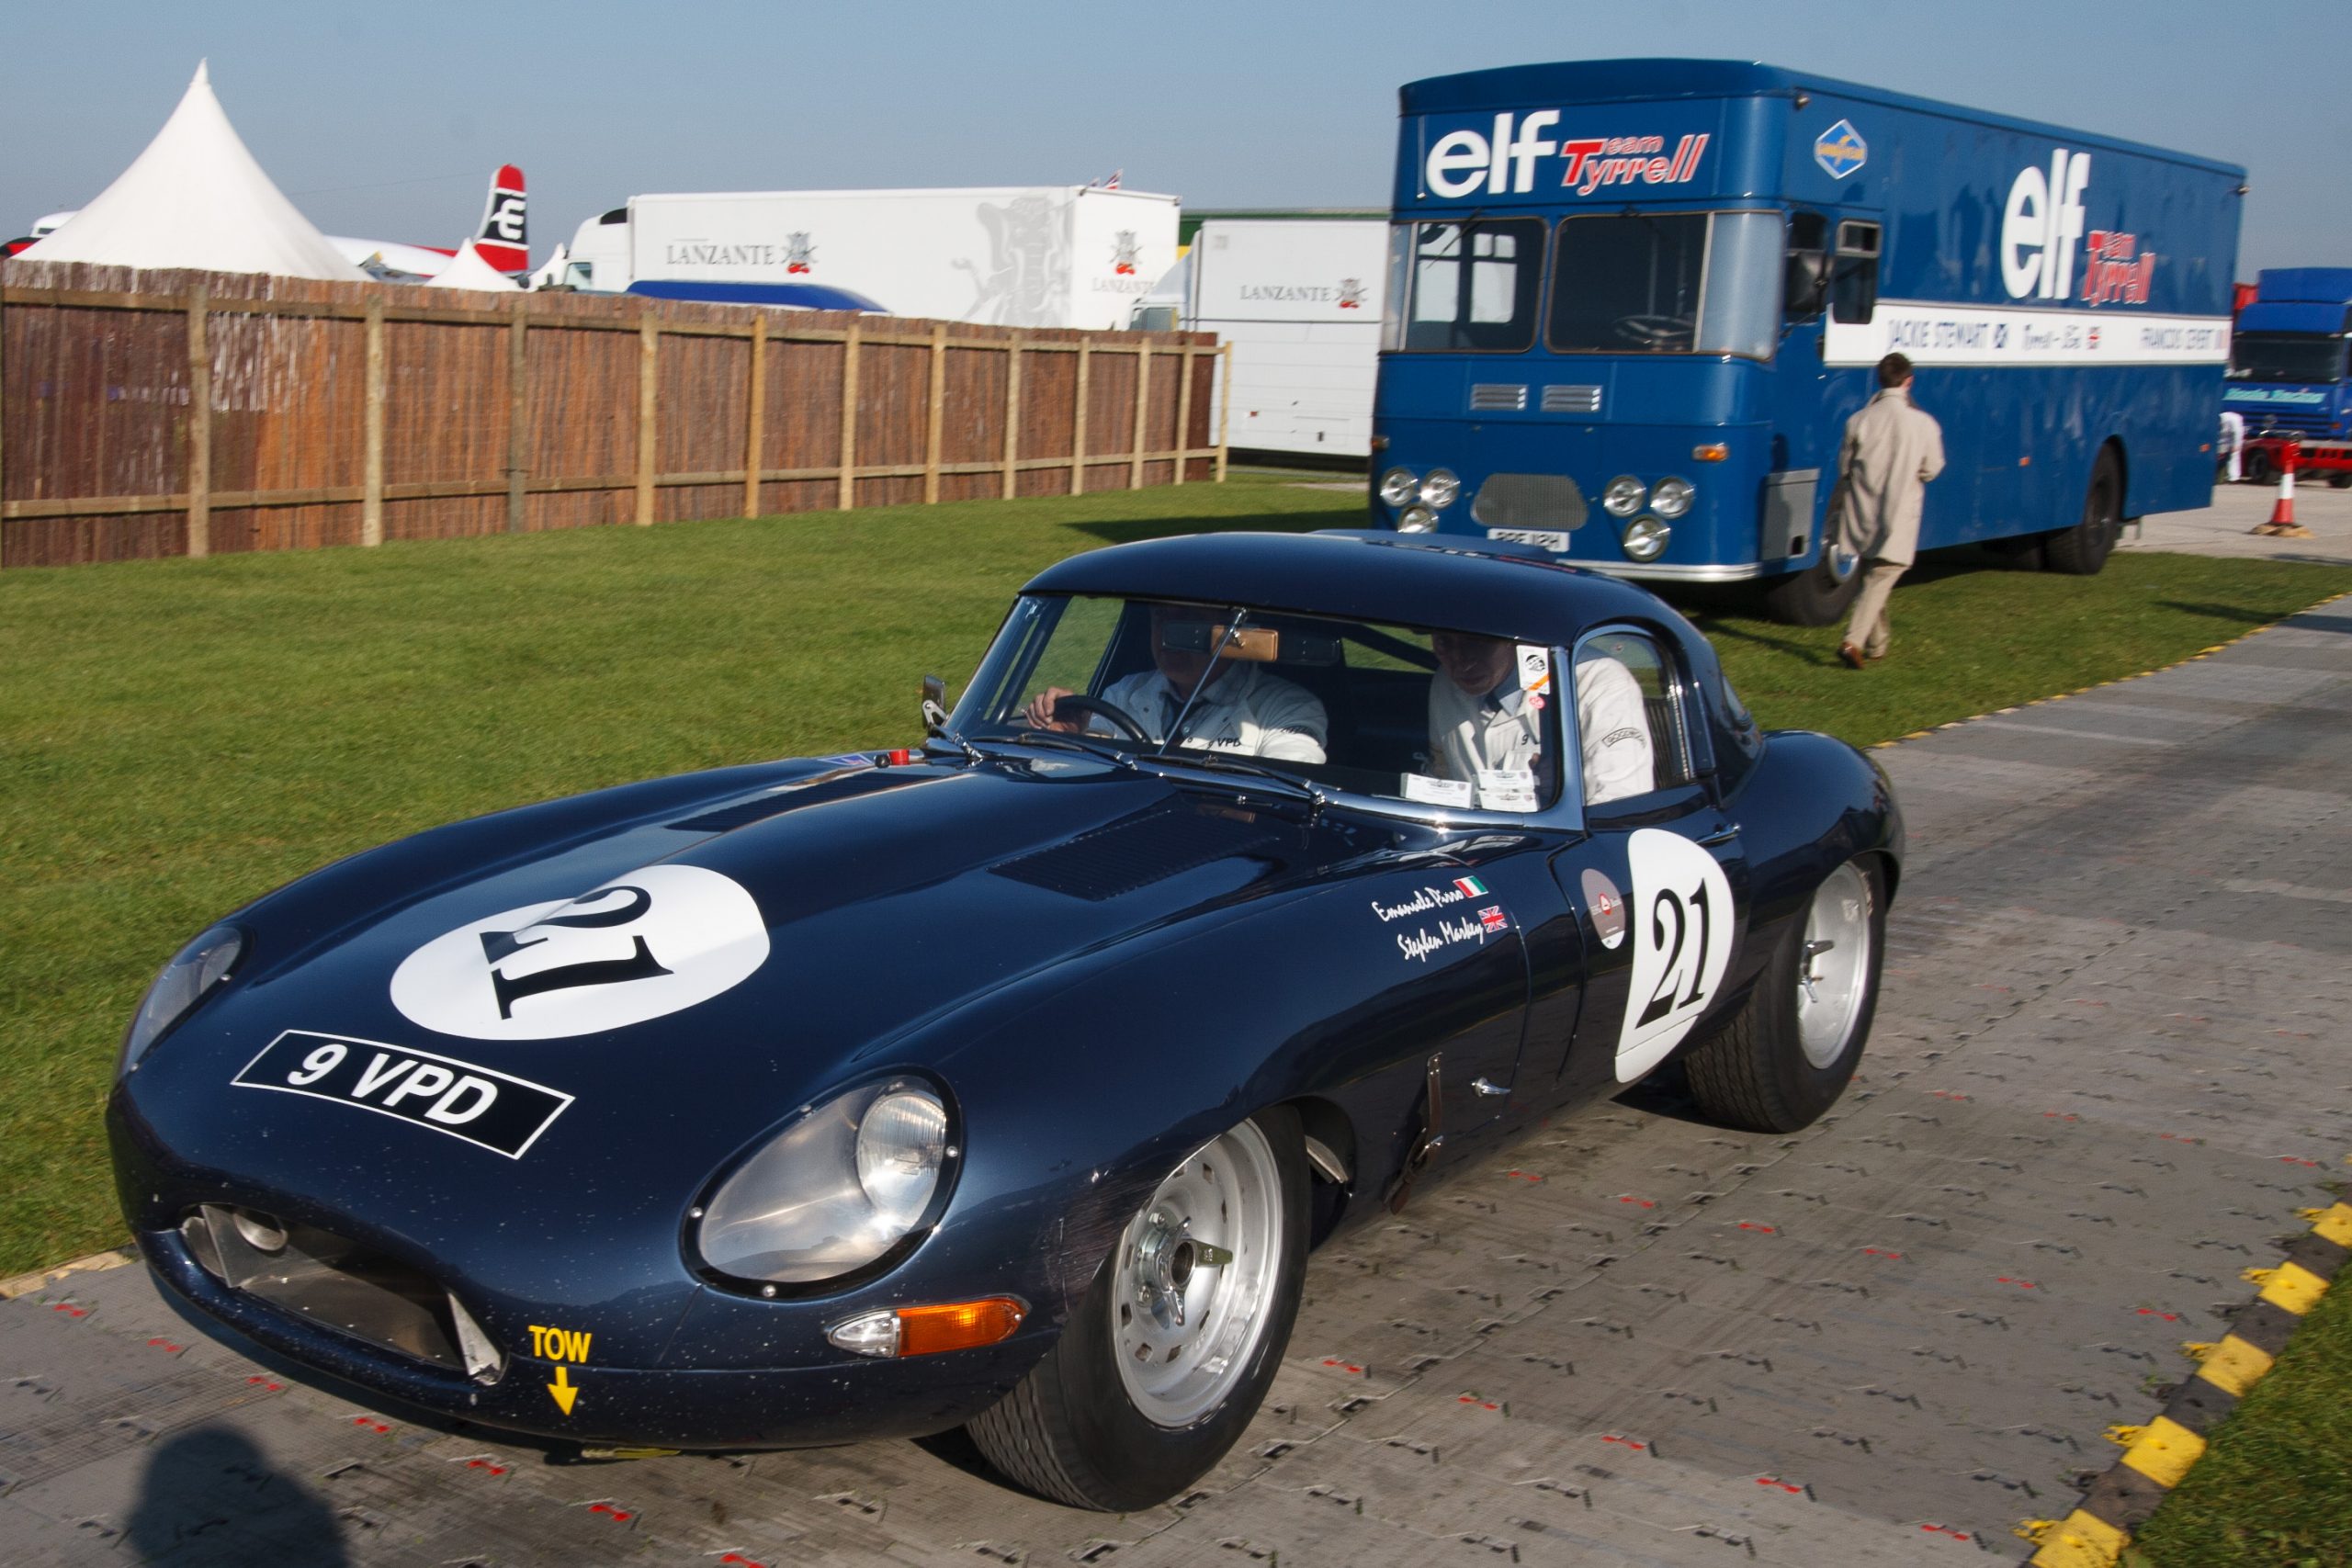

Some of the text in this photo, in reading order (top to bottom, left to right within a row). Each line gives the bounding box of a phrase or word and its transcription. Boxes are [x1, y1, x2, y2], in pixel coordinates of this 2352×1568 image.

[1425, 109, 1561, 199] elf
[1559, 133, 1711, 197] Tyrrell
[666, 244, 775, 265] LANZANTE
[2000, 148, 2091, 299] elf
[1240, 284, 1332, 302] LANZANTE
[1371, 890, 1435, 922] Emanuele
[480, 885, 674, 1021] 21
[1634, 876, 1711, 1030] 21
[287, 1043, 499, 1125] 9 VPD
[527, 1325, 593, 1363] TOW
